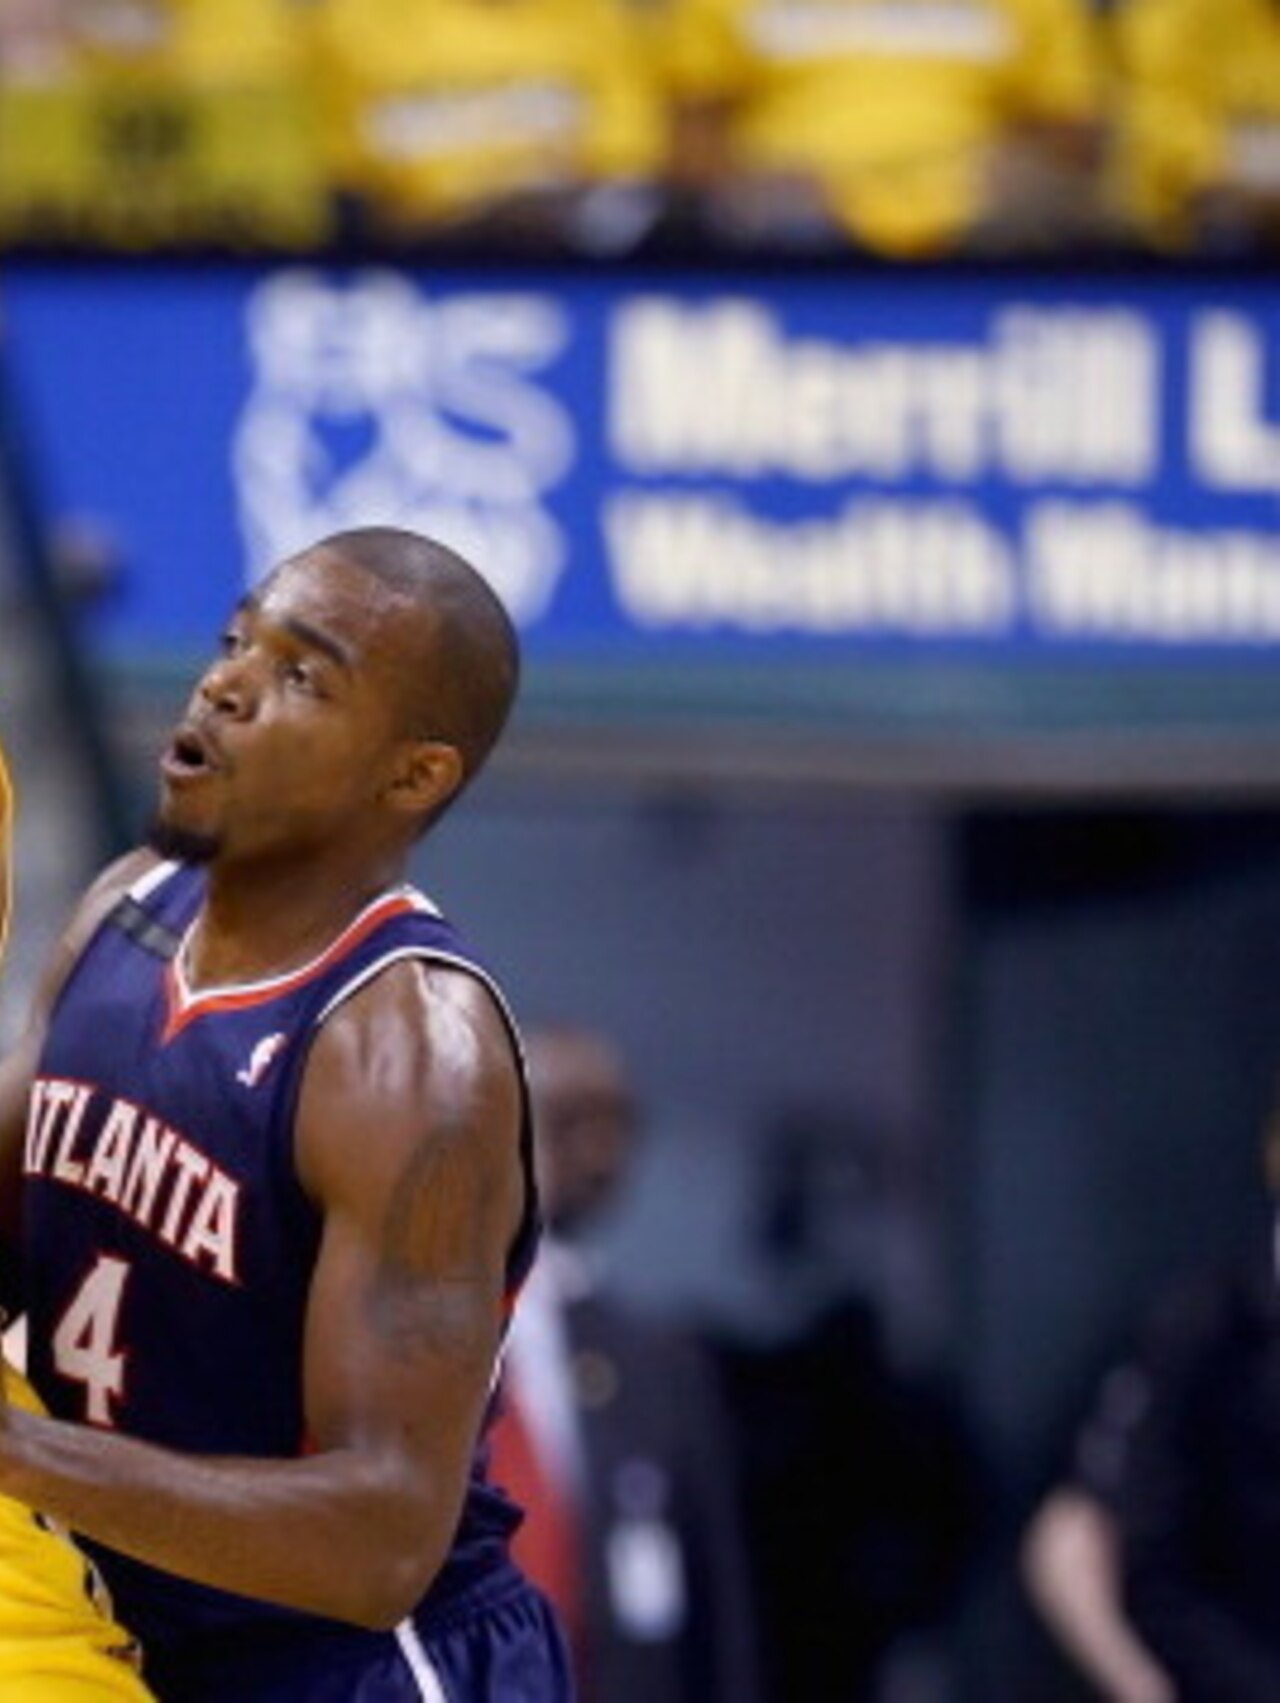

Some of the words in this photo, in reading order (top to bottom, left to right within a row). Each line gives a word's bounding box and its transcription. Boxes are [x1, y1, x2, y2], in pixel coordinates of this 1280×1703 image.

[608, 296, 1160, 482] Merrill
[602, 490, 1020, 634] Wealth
[52, 1252, 134, 1430] 4
